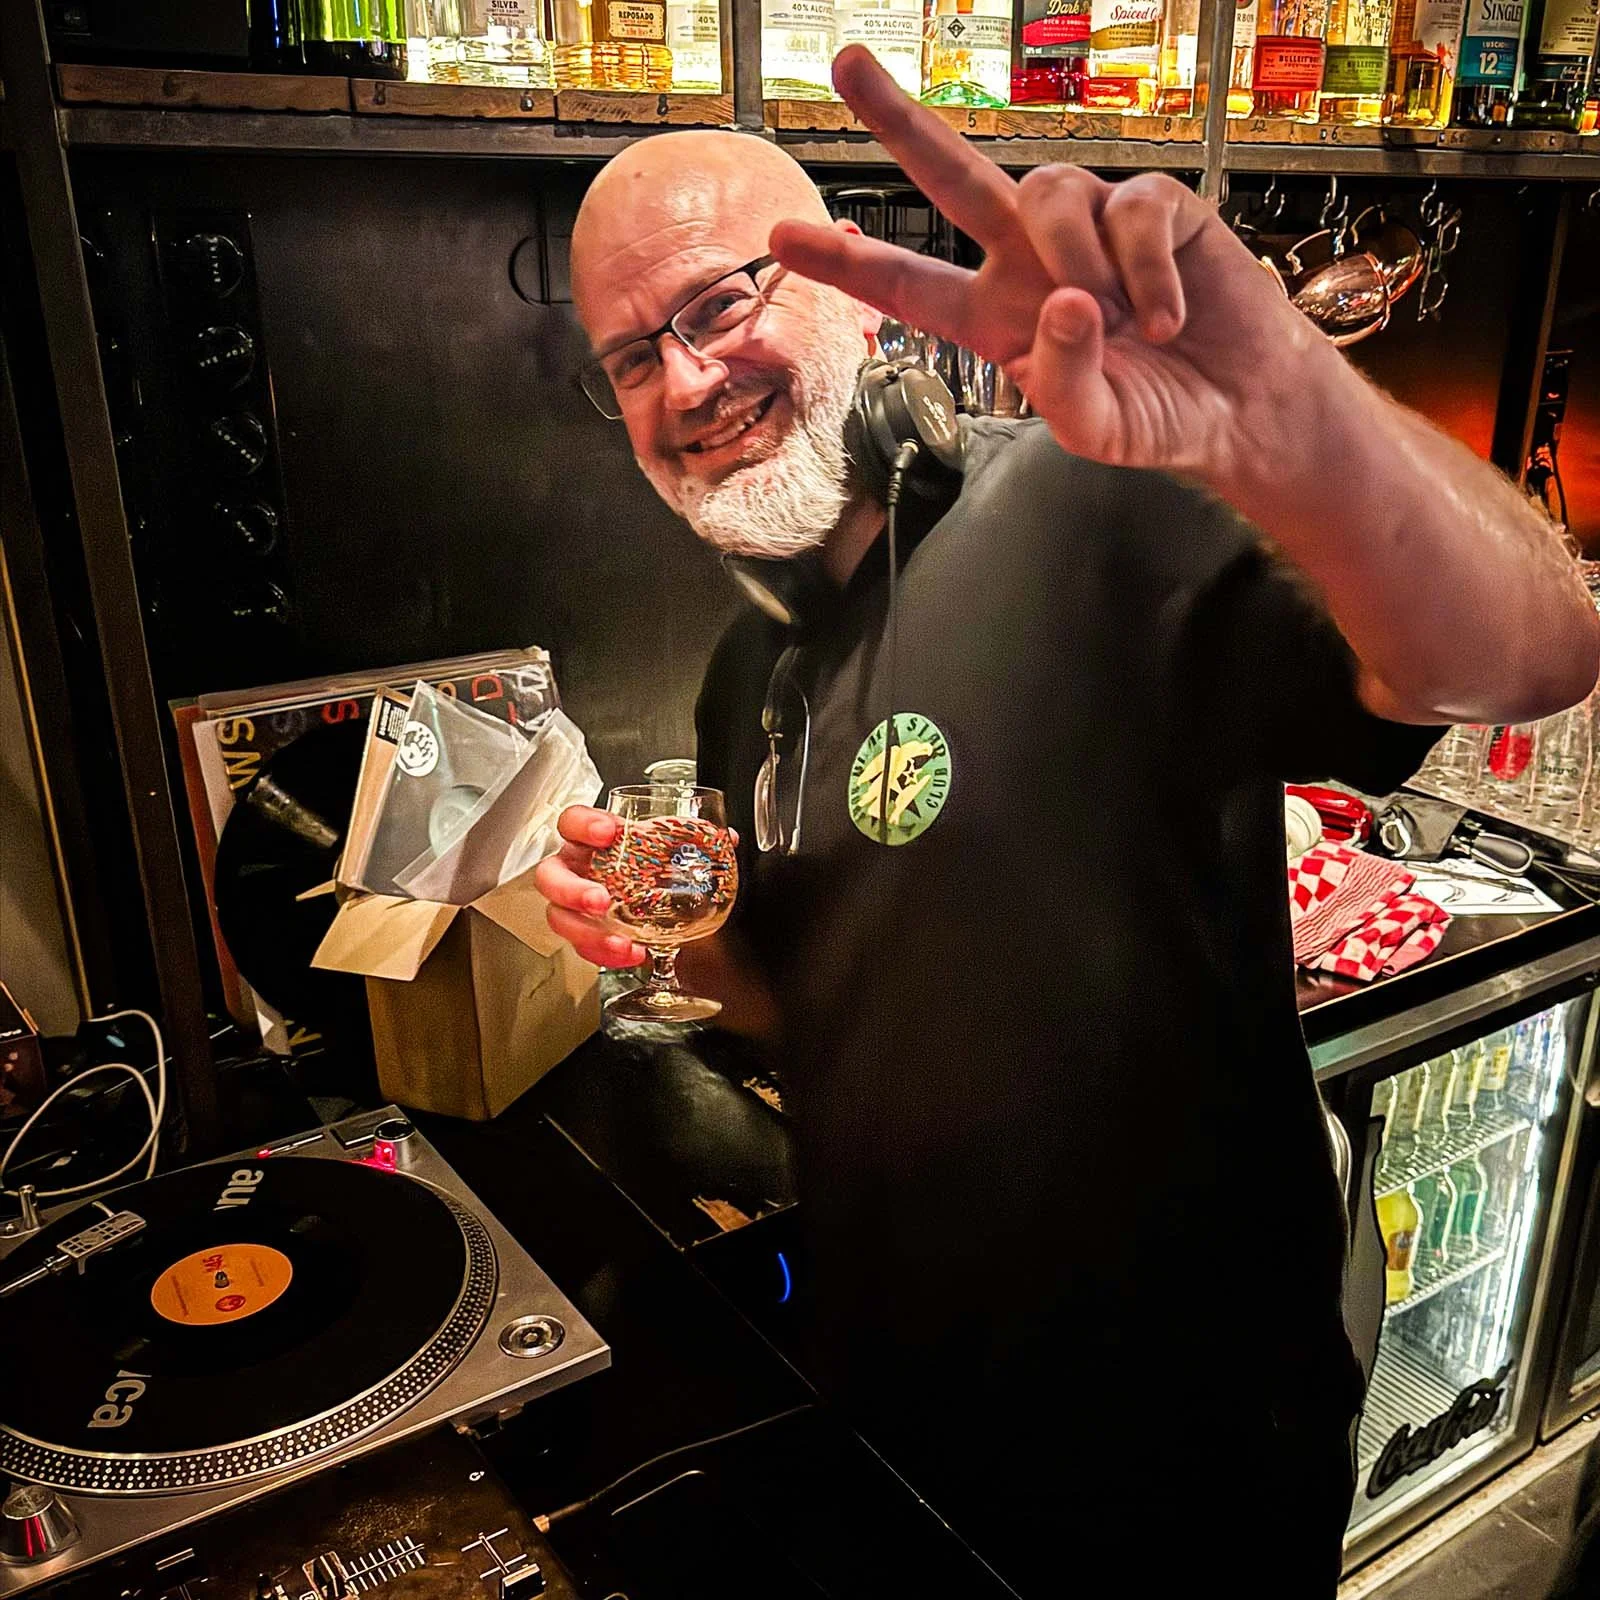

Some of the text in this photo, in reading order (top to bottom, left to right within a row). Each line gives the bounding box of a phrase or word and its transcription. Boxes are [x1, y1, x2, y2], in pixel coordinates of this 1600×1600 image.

[491, 0, 518, 9] SILVER
[1047, 0, 1080, 15] Dark
[618, 11, 655, 20] REPOSADO
[1110, 5, 1150, 21] Spiced
[863, 19, 881, 28] 40%
[1479, 52, 1498, 75] 12
[967, 110, 978, 128] 5
[926, 767, 949, 809] CLUB
[213, 1169, 265, 1211] au
